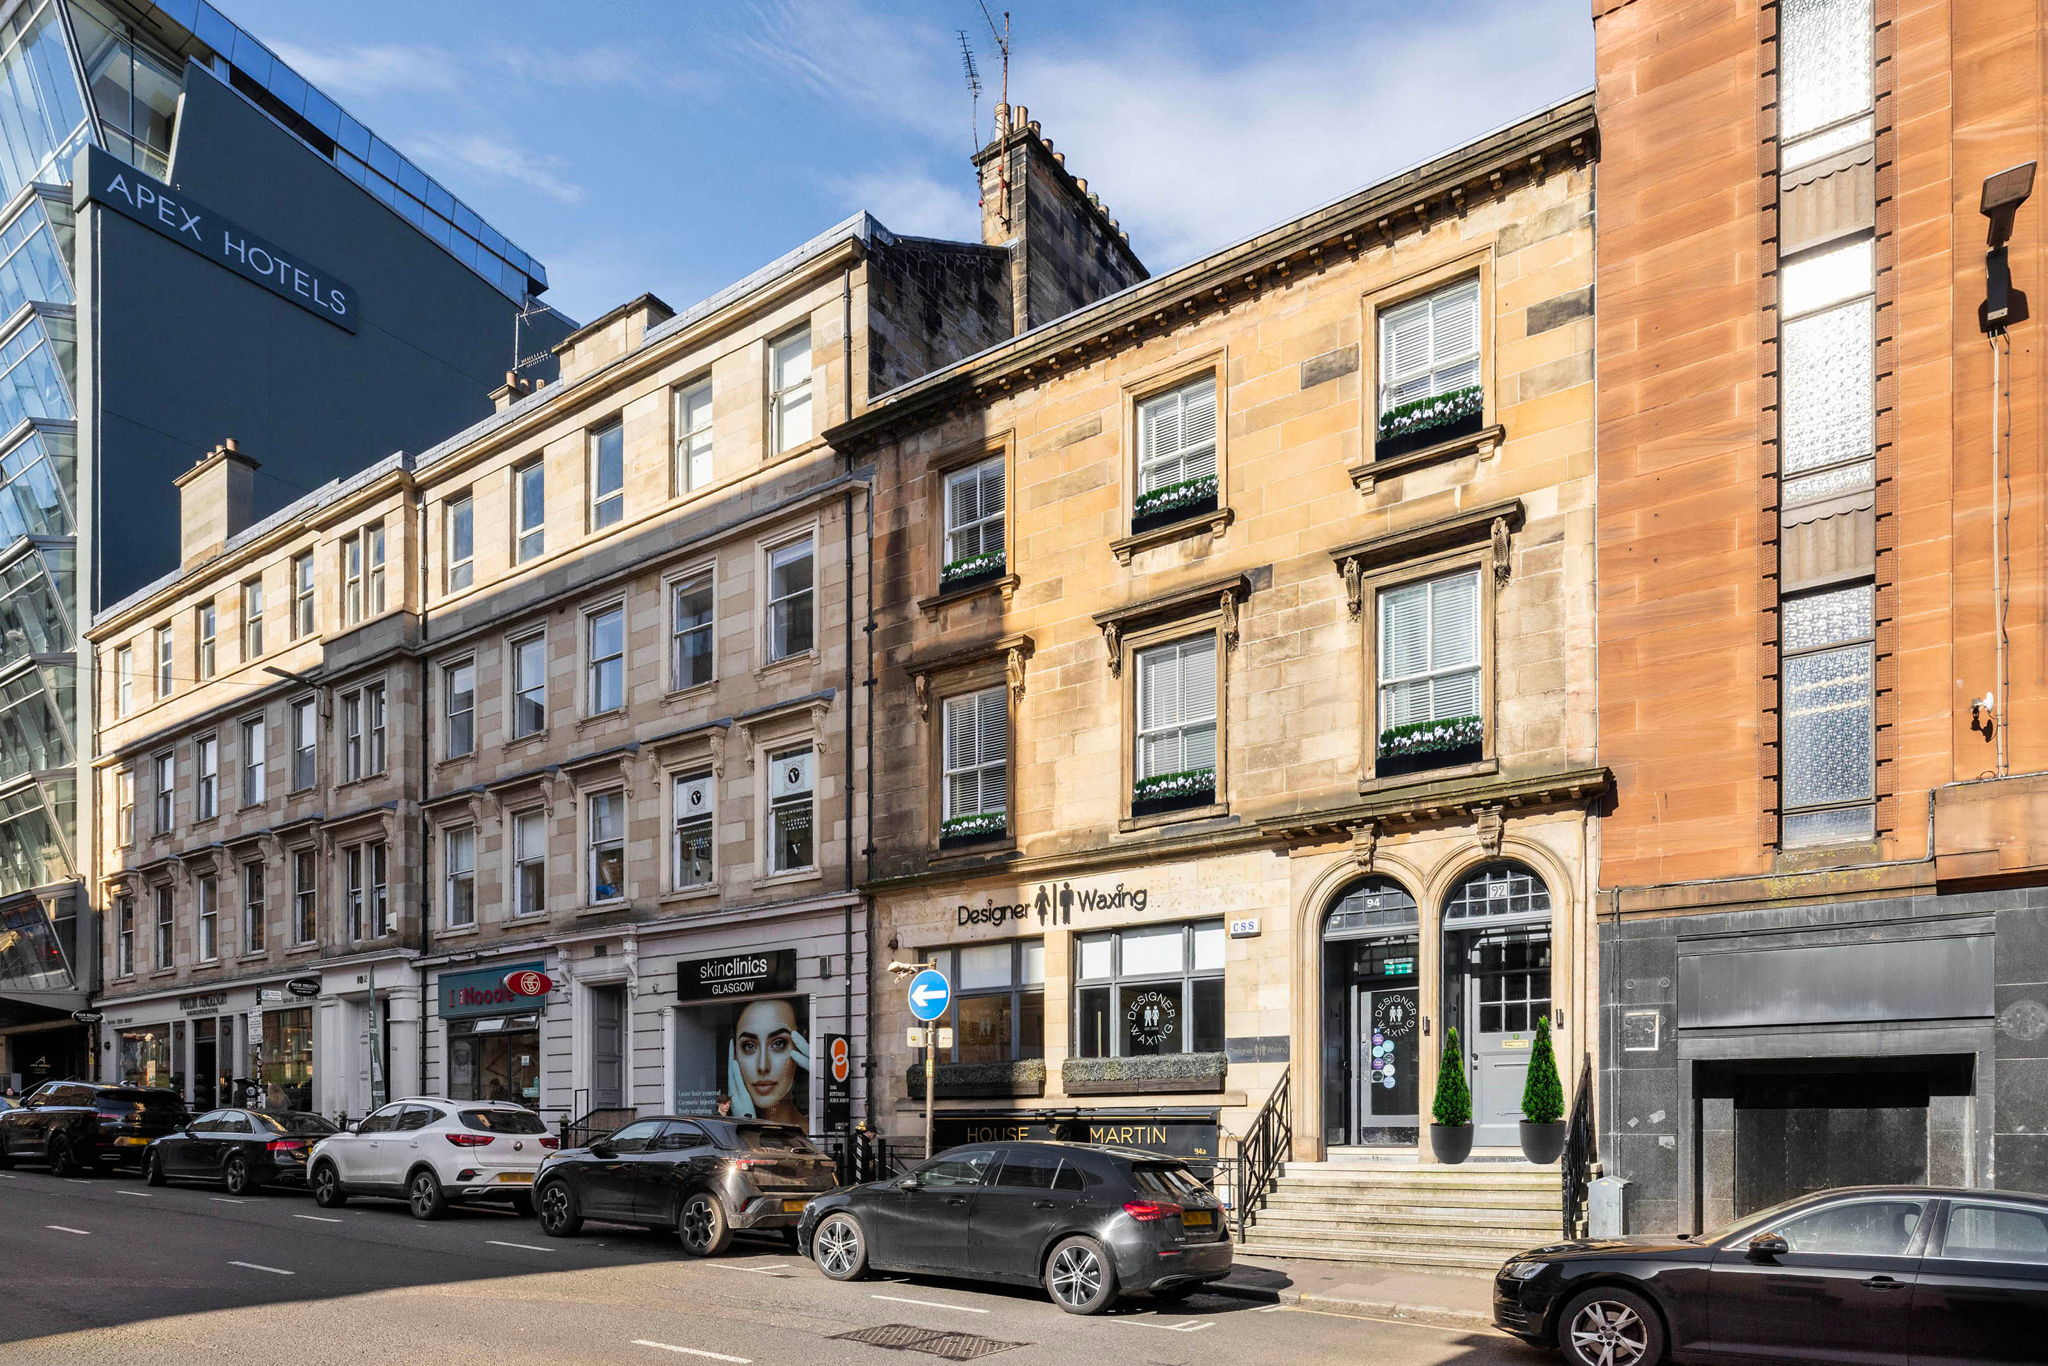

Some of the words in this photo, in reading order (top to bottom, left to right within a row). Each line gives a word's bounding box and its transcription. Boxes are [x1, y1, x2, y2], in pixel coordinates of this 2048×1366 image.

[106, 173, 203, 241] APEX
[224, 231, 347, 315] HOTELS
[1491, 885, 1506, 898] 92
[958, 899, 1031, 926] Designer
[1077, 883, 1148, 911] Waxing
[1366, 898, 1380, 908] 94
[700, 956, 767, 978] skinclinics
[711, 981, 754, 995] GLASGOW
[1127, 991, 1176, 1020] DESIGNER
[1374, 994, 1417, 1017] DESIGNER
[1130, 1022, 1174, 1046] WAXING
[1377, 1019, 1415, 1037] WAXING
[967, 1127, 1030, 1142] HOUSE
[1089, 1126, 1167, 1144] MARTIN
